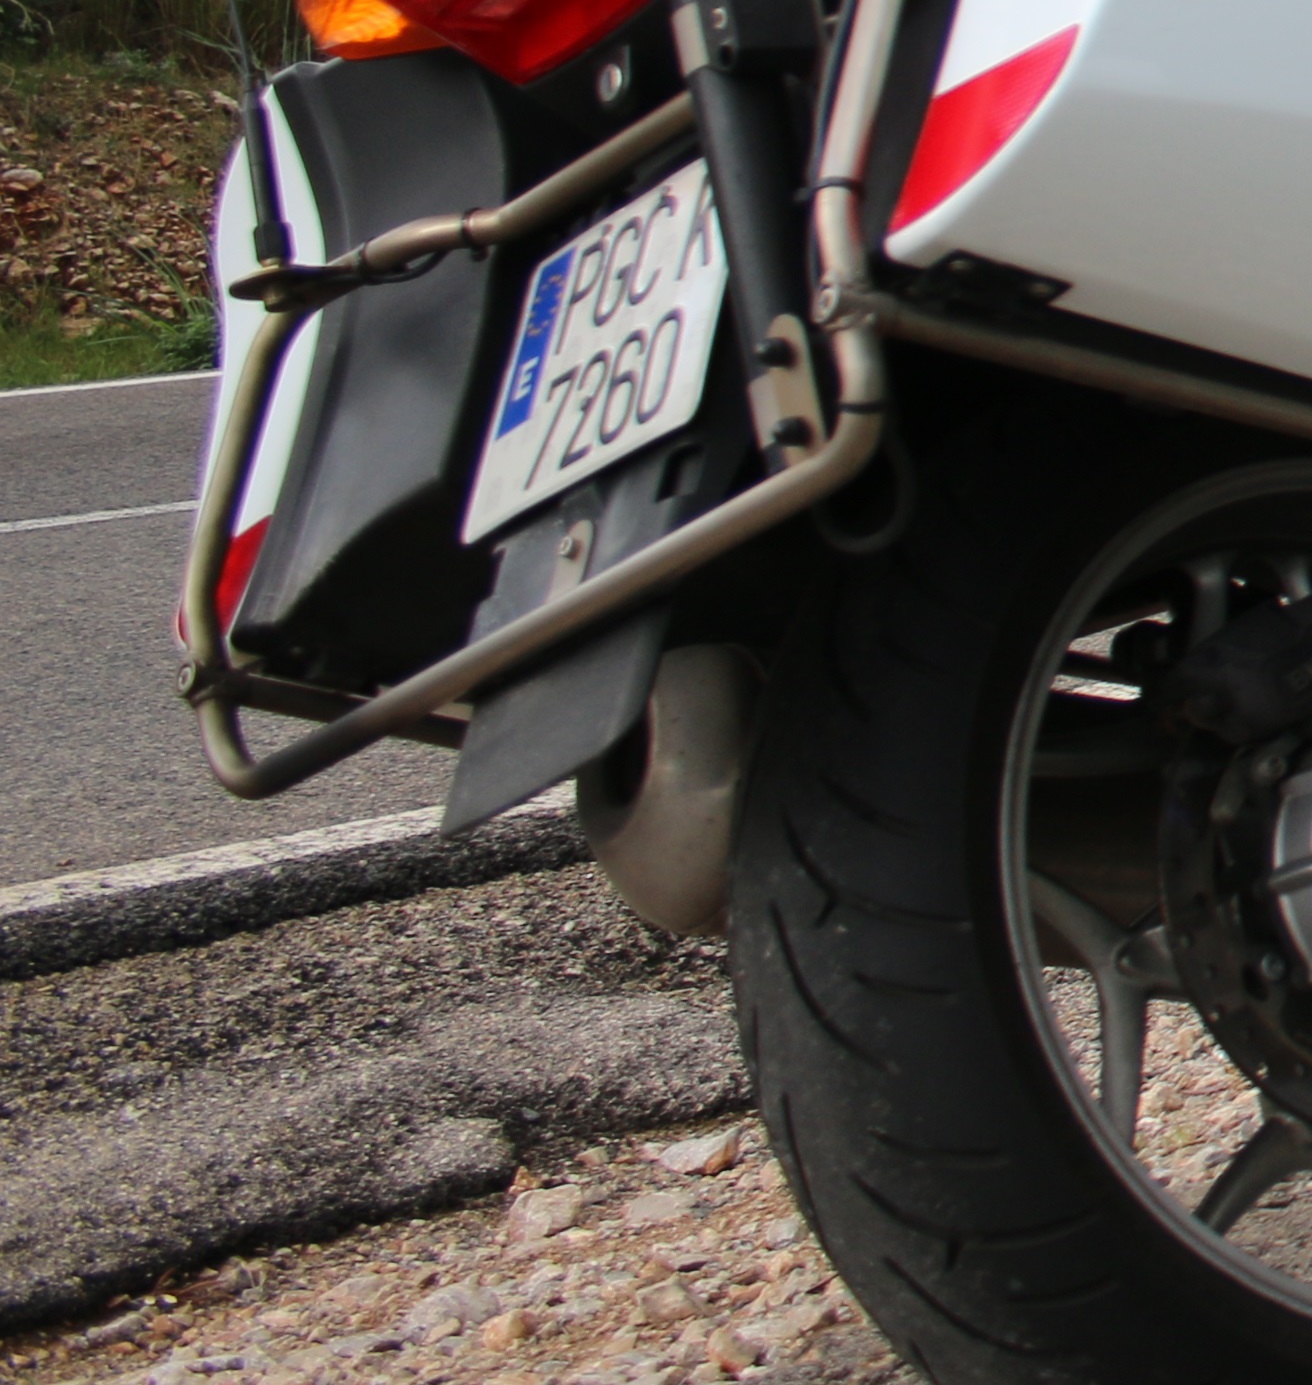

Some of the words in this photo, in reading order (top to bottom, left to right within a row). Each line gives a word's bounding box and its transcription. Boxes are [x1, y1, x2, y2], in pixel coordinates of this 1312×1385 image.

[555, 198, 675, 355] PGC
[512, 360, 538, 401] E
[524, 310, 684, 490] 7260
